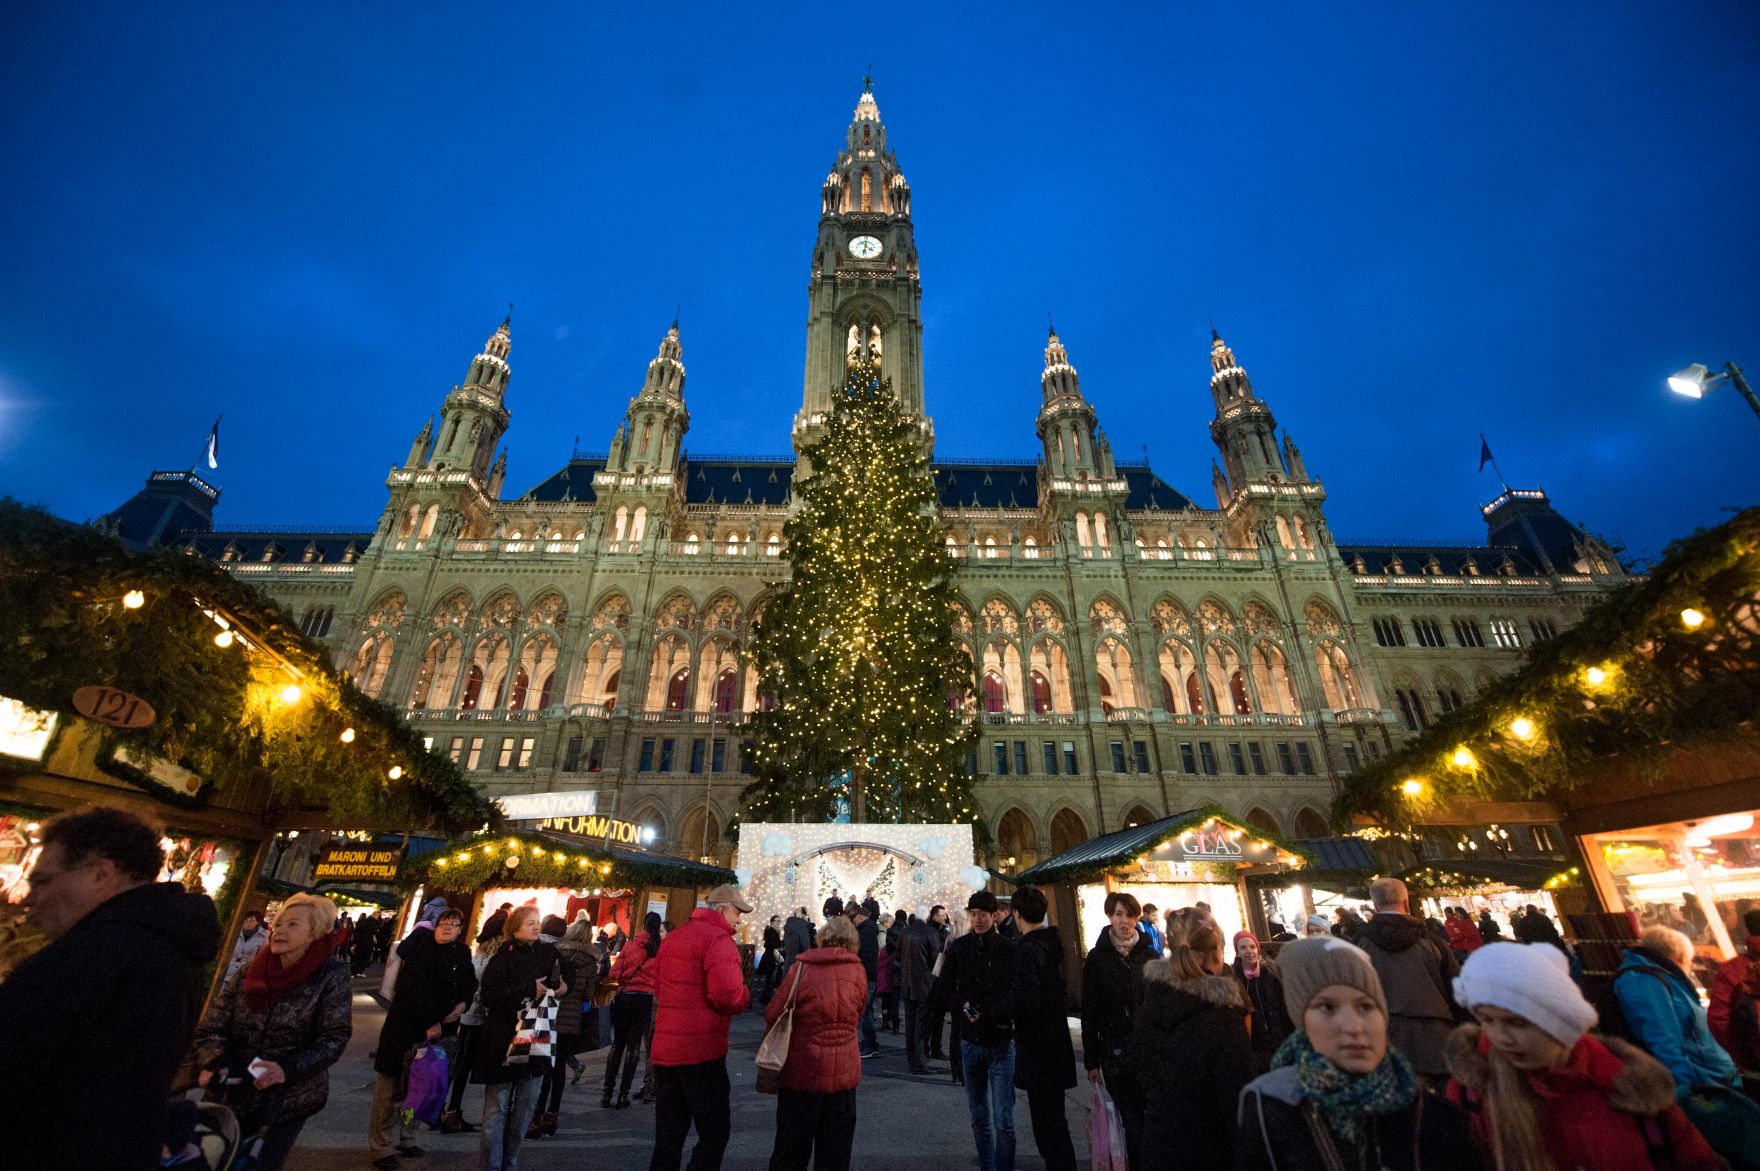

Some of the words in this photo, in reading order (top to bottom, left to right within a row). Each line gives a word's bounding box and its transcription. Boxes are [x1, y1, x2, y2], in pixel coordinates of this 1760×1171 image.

[91, 689, 140, 725] 121
[1180, 833, 1242, 855] GLAS
[328, 850, 368, 862] MARONI
[370, 851, 392, 863] UND
[316, 864, 397, 876] BRATKARTOFFELN
